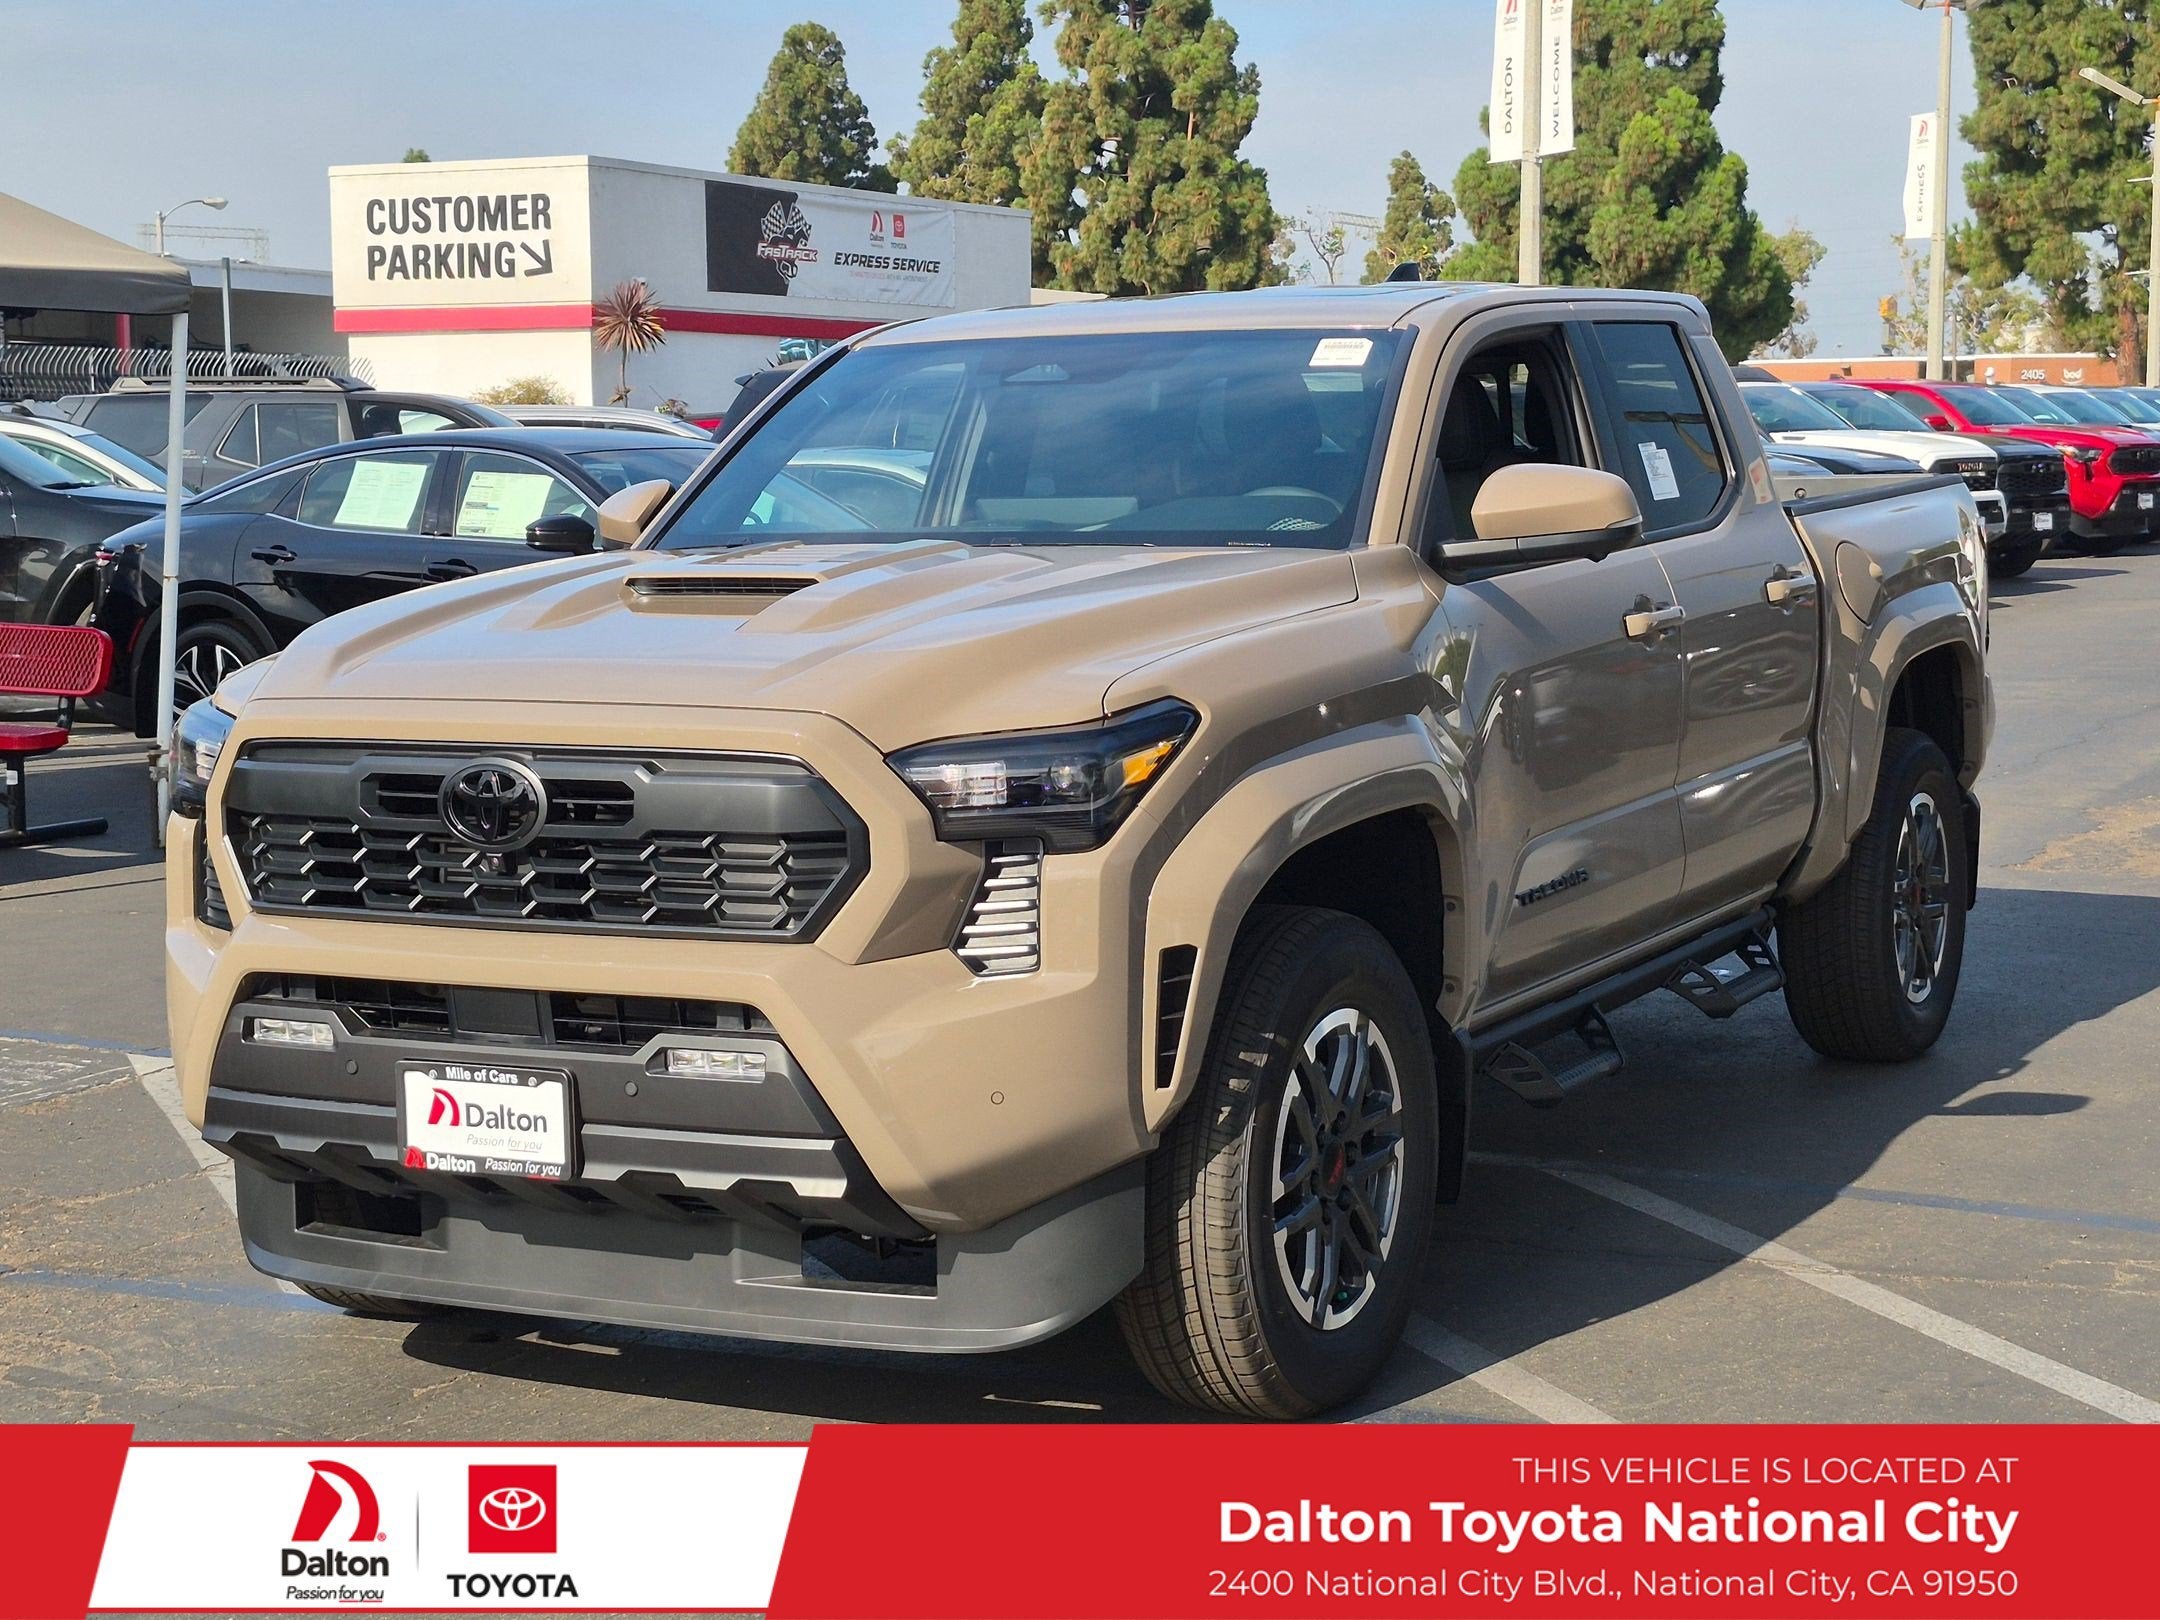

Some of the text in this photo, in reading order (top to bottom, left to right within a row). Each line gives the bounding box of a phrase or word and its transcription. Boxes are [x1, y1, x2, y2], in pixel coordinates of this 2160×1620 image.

[1504, 57, 1513, 134] DALTON
[1552, 36, 1560, 138] WELCOME
[366, 193, 552, 235] CUSTOMER
[367, 240, 516, 281] PARKING
[834, 251, 941, 274] EXPRESS SERVICE
[2020, 368, 2046, 380] 2405
[445, 1066, 518, 1084] Mile of Cars
[465, 1102, 547, 1133] Dalton
[466, 1134, 543, 1151] Passion for you
[426, 1152, 562, 1177] Dalton Passion for you
